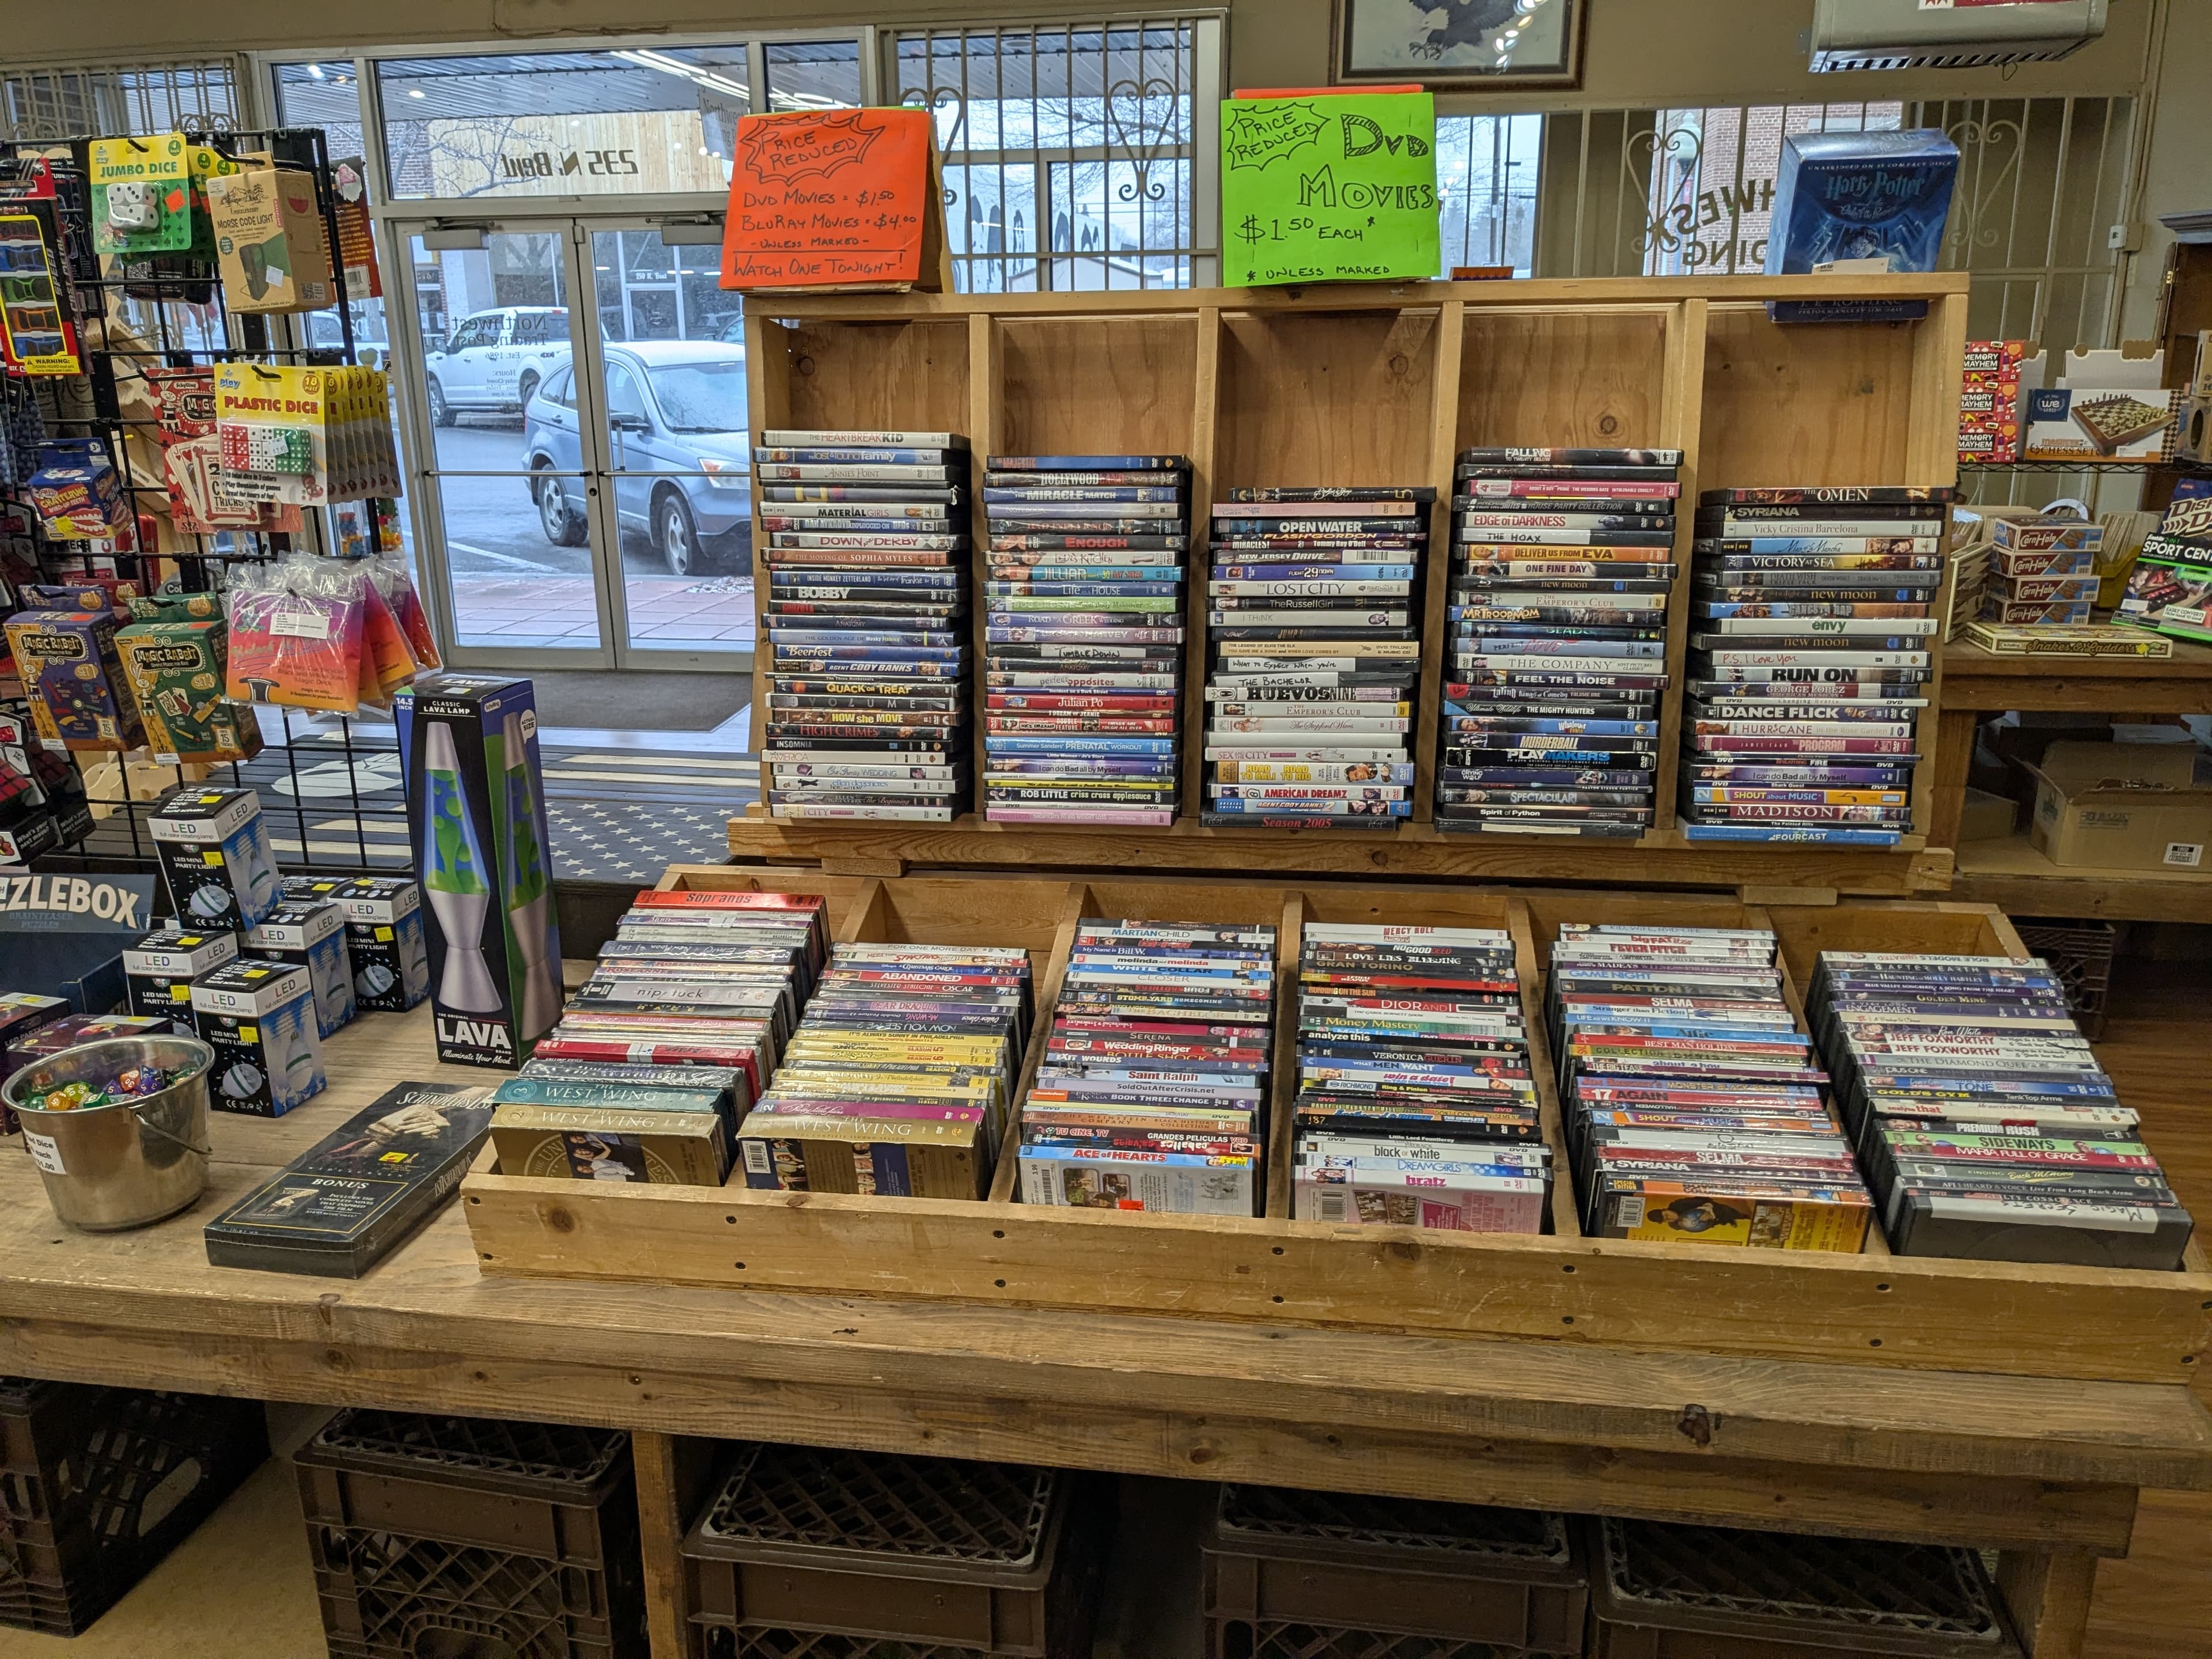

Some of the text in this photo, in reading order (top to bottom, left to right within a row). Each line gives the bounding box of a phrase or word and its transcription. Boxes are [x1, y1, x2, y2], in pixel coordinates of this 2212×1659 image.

[1238, 112, 1296, 138] PRICE
[760, 131, 815, 154] PRICE
[1234, 123, 1318, 161] REDUCED
[1341, 114, 1429, 159] DVD
[770, 138, 857, 171] REDUCED
[100, 162, 177, 177] JUMBO DICE
[1297, 164, 1433, 209] MOVIES
[1825, 170, 1925, 199] Harry Potter
[744, 192, 777, 207] DVD
[783, 188, 835, 204] MOVIES
[217, 213, 273, 229] MORSE CODE LIGHT
[812, 214, 859, 228] MOVIES
[1234, 214, 1362, 245] $1.50 EACH
[760, 237, 859, 249] UNLESS MARKED
[734, 253, 903, 276] WATCH ONE TONIGHT!
[46, 248, 62, 296] SPEED
[1266, 266, 1389, 279] UNLESS MARKED
[1963, 359, 1998, 368] MAYHEM
[224, 396, 318, 414] PLASTIC DICE
[821, 434, 882, 442] HEARTBREAK
[882, 433, 904, 443] KID
[2041, 447, 2074, 455] CHESS
[41, 484, 88, 509] CHATTERING
[1817, 489, 1869, 502] OMEN
[818, 506, 889, 517] MATERIAL GIRLS
[1737, 507, 1800, 517] SYRIANA
[1279, 521, 1362, 532] OPEN WATER
[1474, 516, 1500, 525] EDGE
[1512, 516, 1566, 526] DARKNESS
[1755, 524, 1858, 536] Vicky Cristina Barcelona
[1065, 537, 1128, 547] ENOUGH
[1511, 533, 1541, 543] HOAX
[1514, 548, 1547, 558] DELIVER
[1582, 549, 1613, 559] EVA
[2143, 541, 2183, 556] SPORT
[1525, 565, 1587, 573] ONE FINE DAY
[798, 588, 851, 599] BOBBY
[1267, 582, 1346, 594] LOST CITY
[1812, 619, 1847, 633] envy
[786, 646, 834, 657] Beerfest
[2027, 639, 2071, 653] Snakes
[2085, 641, 2137, 654] Ladders
[137, 647, 197, 662] MAGIC RABBIT
[1239, 676, 1311, 686] THE BACHELOR
[1577, 676, 1616, 685] NOISE
[827, 684, 865, 693] QUACK
[878, 685, 910, 694] TREAT
[1058, 698, 1104, 707] Julian Po
[1722, 707, 1839, 718] DANCE FLICK
[521, 716, 535, 725] ACTUAL
[523, 722, 535, 730] SIZE
[220, 733, 229, 743] 15
[1041, 790, 1068, 798] LITTLE
[1264, 787, 1347, 798] AMERICAN DREAMZ
[1737, 806, 1834, 818] MADISON
[171, 823, 196, 834] LED
[1262, 817, 1332, 828] Season 2005
[0, 876, 139, 929] ZLEBOX
[260, 929, 285, 941] LED
[880, 972, 962, 982] ABANDONED
[1651, 997, 1694, 1007] SELMA
[437, 1018, 512, 1049] LAVA
[1889, 1033, 1994, 1045] JEFF FOXWORTHY
[1104, 1042, 1191, 1053] Wedding Ringer
[442, 1050, 512, 1065] Illuminate Your Mood
[1373, 1051, 1424, 1061] VERONICA
[1372, 1062, 1434, 1071] MEN WANT
[1128, 1070, 1198, 1082] Saint Ralph
[794, 1121, 912, 1135] WEST WING
[1956, 1123, 2040, 1136] PREMIUM RUSH
[1147, 1132, 1229, 1143] GRANDES PELICULAS
[1980, 1137, 2055, 1150] SIDEWAYS
[1073, 1149, 1100, 1158] ACE
[1112, 1151, 1166, 1162] HEARTS
[1374, 1145, 1400, 1158] black
[1410, 1147, 1440, 1160] white
[312, 1178, 369, 1190] BONUS
[1406, 1175, 1446, 1187] bratz
